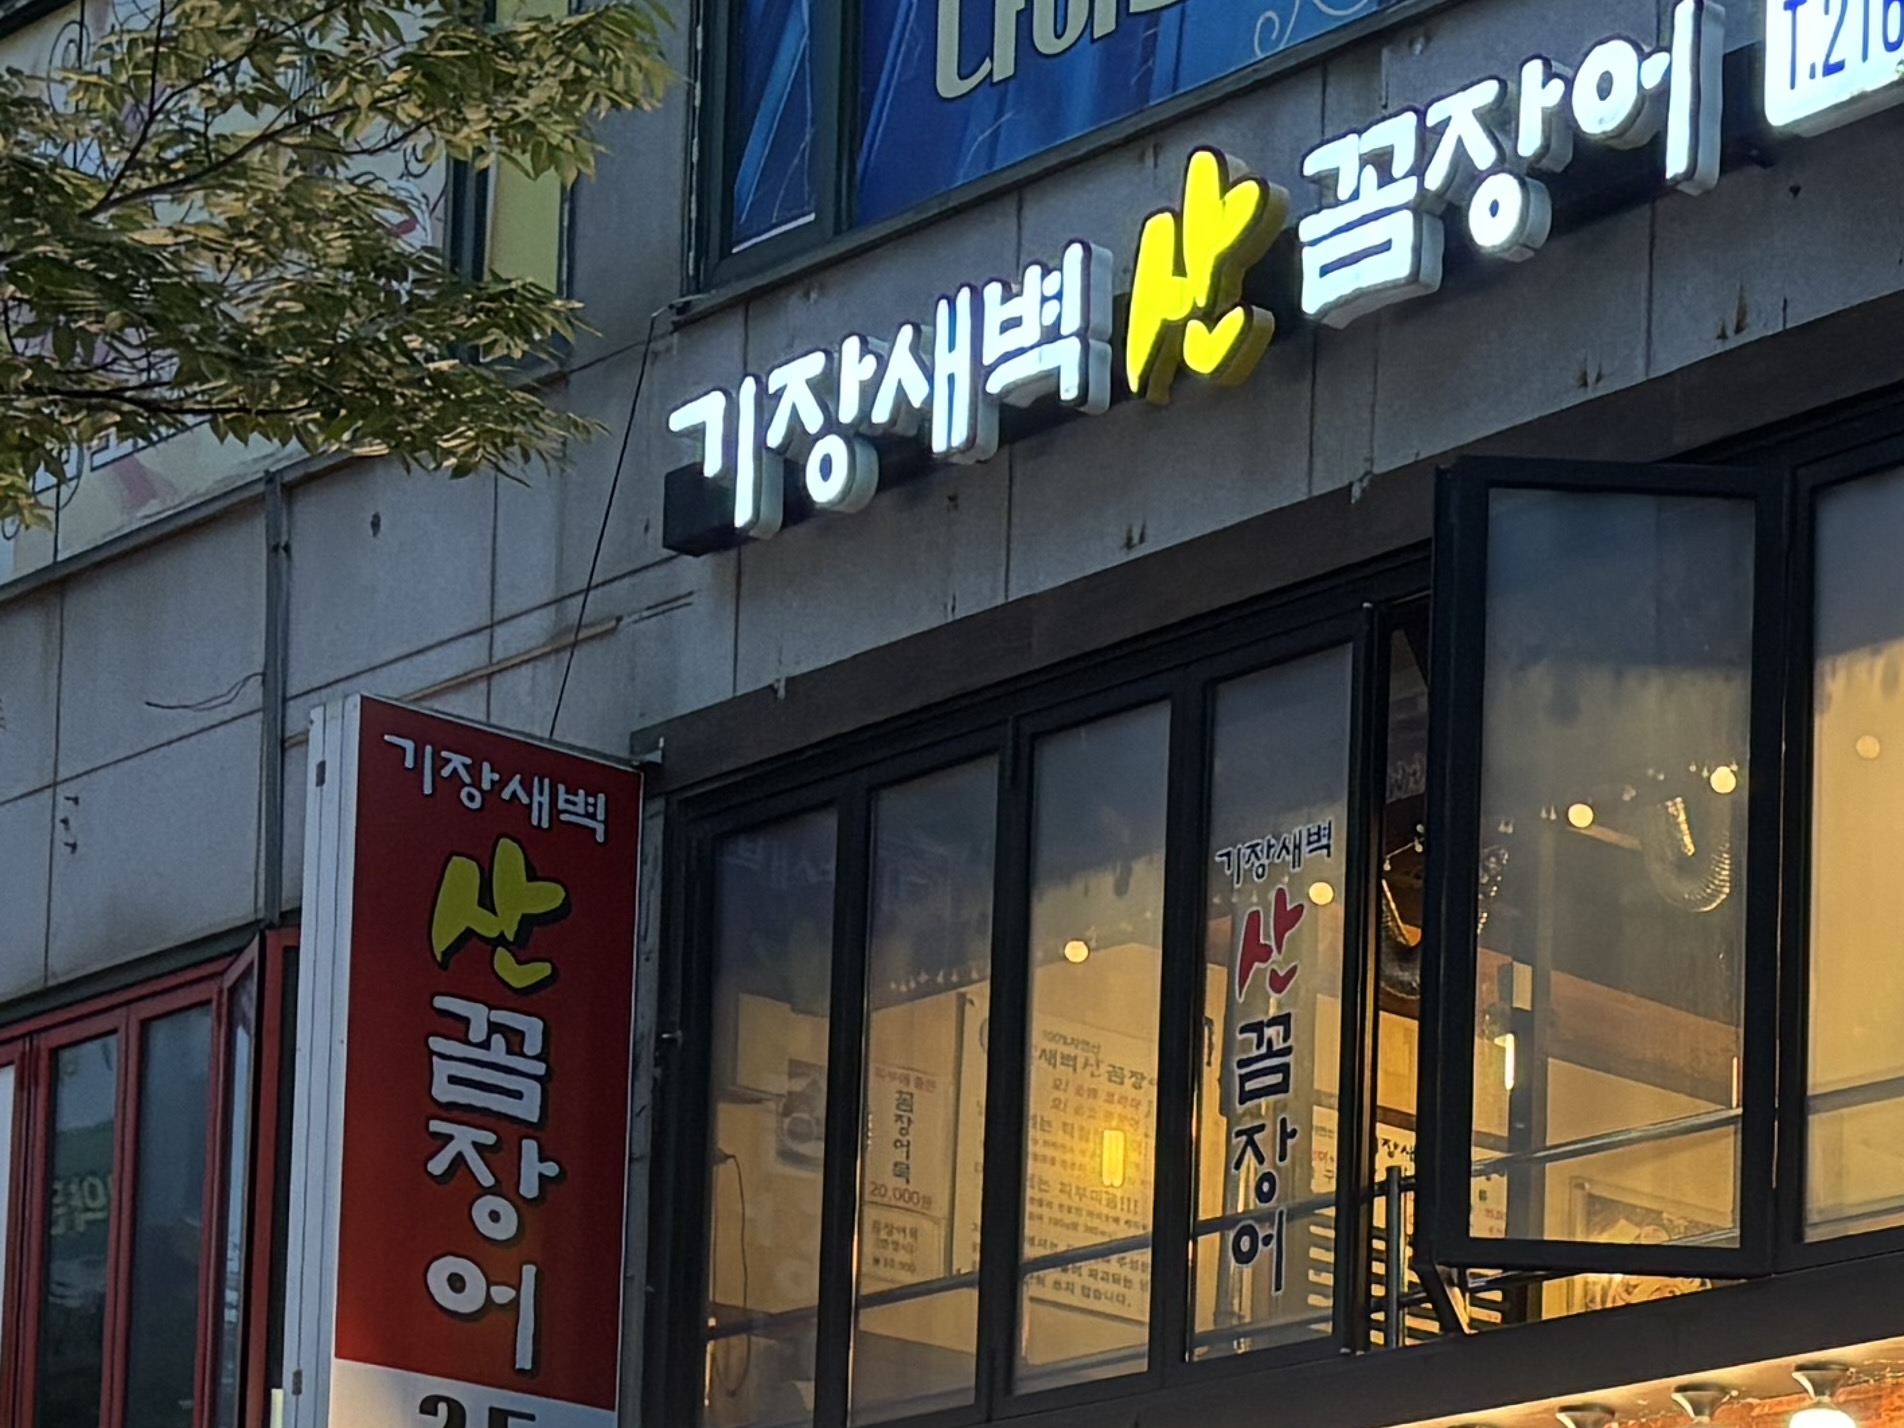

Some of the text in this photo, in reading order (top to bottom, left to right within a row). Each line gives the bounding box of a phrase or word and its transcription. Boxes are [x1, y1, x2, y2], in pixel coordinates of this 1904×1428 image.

[669, 0, 1706, 530] 기장새벽 산 꼼장어
[383, 733, 608, 844] 기장새벽
[1214, 819, 1334, 887] 기장새벽
[430, 838, 567, 990] 산
[1235, 886, 1306, 1000] 산
[426, 995, 560, 1373] 꼼장어
[1229, 1013, 1299, 1298] 꼼장어
